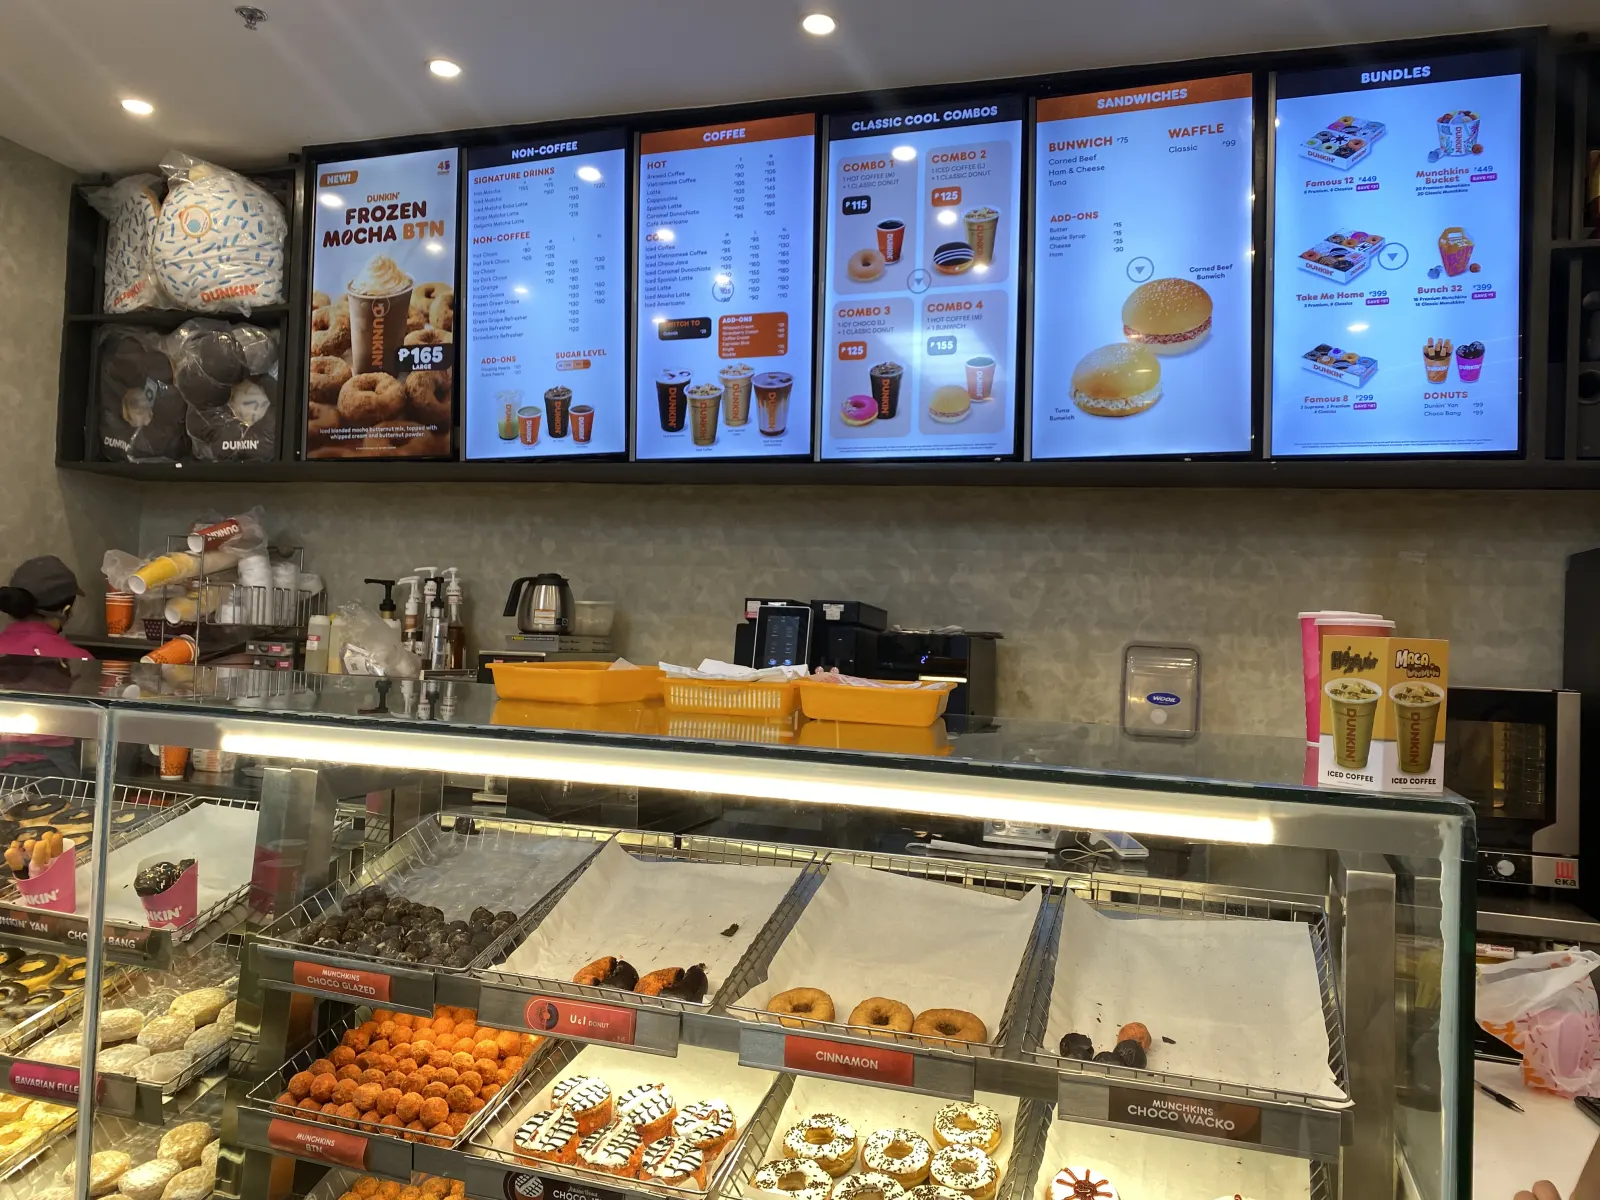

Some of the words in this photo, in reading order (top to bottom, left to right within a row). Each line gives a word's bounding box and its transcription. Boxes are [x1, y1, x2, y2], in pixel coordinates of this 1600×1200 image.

[1361, 66, 1431, 84] BUNDLES
[1097, 88, 1188, 109] SANDWICHES
[852, 117, 902, 131] CLASSIC
[905, 113, 940, 126] COOL
[944, 106, 998, 121] COMBOS
[703, 128, 746, 142] COFFEE
[1168, 123, 1224, 140] WAFFLE
[512, 141, 578, 159] NON-COFFEE
[1048, 136, 1113, 152] BUNWICH
[1168, 144, 1198, 154] Classic
[932, 150, 976, 164] COMBO
[980, 150, 987, 159] 2
[1049, 156, 1078, 166] Corned
[1080, 154, 1097, 163] Beef
[647, 160, 667, 170] HOT
[843, 160, 886, 172] COMBO
[889, 160, 894, 168] 1
[1049, 167, 1066, 176] Ham
[1068, 166, 1074, 174] &
[1076, 164, 1105, 174] Cheese
[326, 172, 351, 185] NEW!
[474, 172, 521, 184] SIGNATURE
[524, 166, 554, 178] DRINKS
[940, 173, 966, 181] CLASSIC
[968, 170, 992, 178] DONUT
[1416, 167, 1470, 178] Munchkins
[878, 179, 900, 187] DONUT
[1048, 179, 1067, 187] Tuna
[1306, 180, 1342, 188] Famous
[1344, 176, 1354, 184] 12
[1426, 175, 1460, 184] Bucket
[366, 192, 400, 204] DUNKIN'
[346, 201, 426, 225] FROZEN
[1050, 211, 1098, 224] ADD-ONS
[323, 224, 397, 247] MOCHA
[402, 220, 444, 240] BTN
[473, 231, 530, 244] NON-COFFEE
[1050, 242, 1072, 250] Cheese
[1190, 265, 1214, 274] Corned
[1216, 264, 1233, 272] Beef
[1196, 272, 1226, 280] Bunwich
[200, 284, 260, 303] DUNKIN'
[1418, 286, 1448, 294] Bunch
[1451, 284, 1463, 292] 32
[1296, 294, 1318, 302] Take
[1320, 292, 1334, 300] Me
[838, 306, 881, 318] COMBO
[884, 306, 890, 315] 3
[928, 302, 972, 312] COMBO
[976, 300, 984, 310] 4
[872, 326, 894, 334] DONUT
[481, 356, 516, 364] ADD-ONS
[556, 350, 581, 359] SUGAR
[583, 349, 606, 358] LEVEL
[1304, 396, 1340, 404] Famous
[1343, 394, 1349, 402] 8
[1424, 391, 1468, 400] DONUTS
[222, 440, 260, 450] DUNKIN'
[1346, 708, 1356, 762] DUNKIN'
[1410, 712, 1420, 766] DUNKIN'
[1328, 770, 1344, 778] ICED
[1346, 772, 1374, 782] COFFEE
[30, 922, 48, 932] YAN
[108, 938, 136, 948] BANG
[322, 969, 360, 982] MUNCHKINS
[307, 976, 340, 988] CHOCO
[342, 982, 376, 995] GLAZED
[588, 1020, 610, 1028] DONUT
[816, 1050, 878, 1070] CINNAMON
[16, 1076, 54, 1090] BAVARIAN
[57, 1083, 80, 1094] FILLE
[1152, 1100, 1214, 1116] MUNCHKINS
[1128, 1104, 1178, 1121] CHOCO
[1183, 1113, 1235, 1131] WACKO
[296, 1132, 336, 1146] MUNCHKINS
[306, 1144, 322, 1153] BTN
